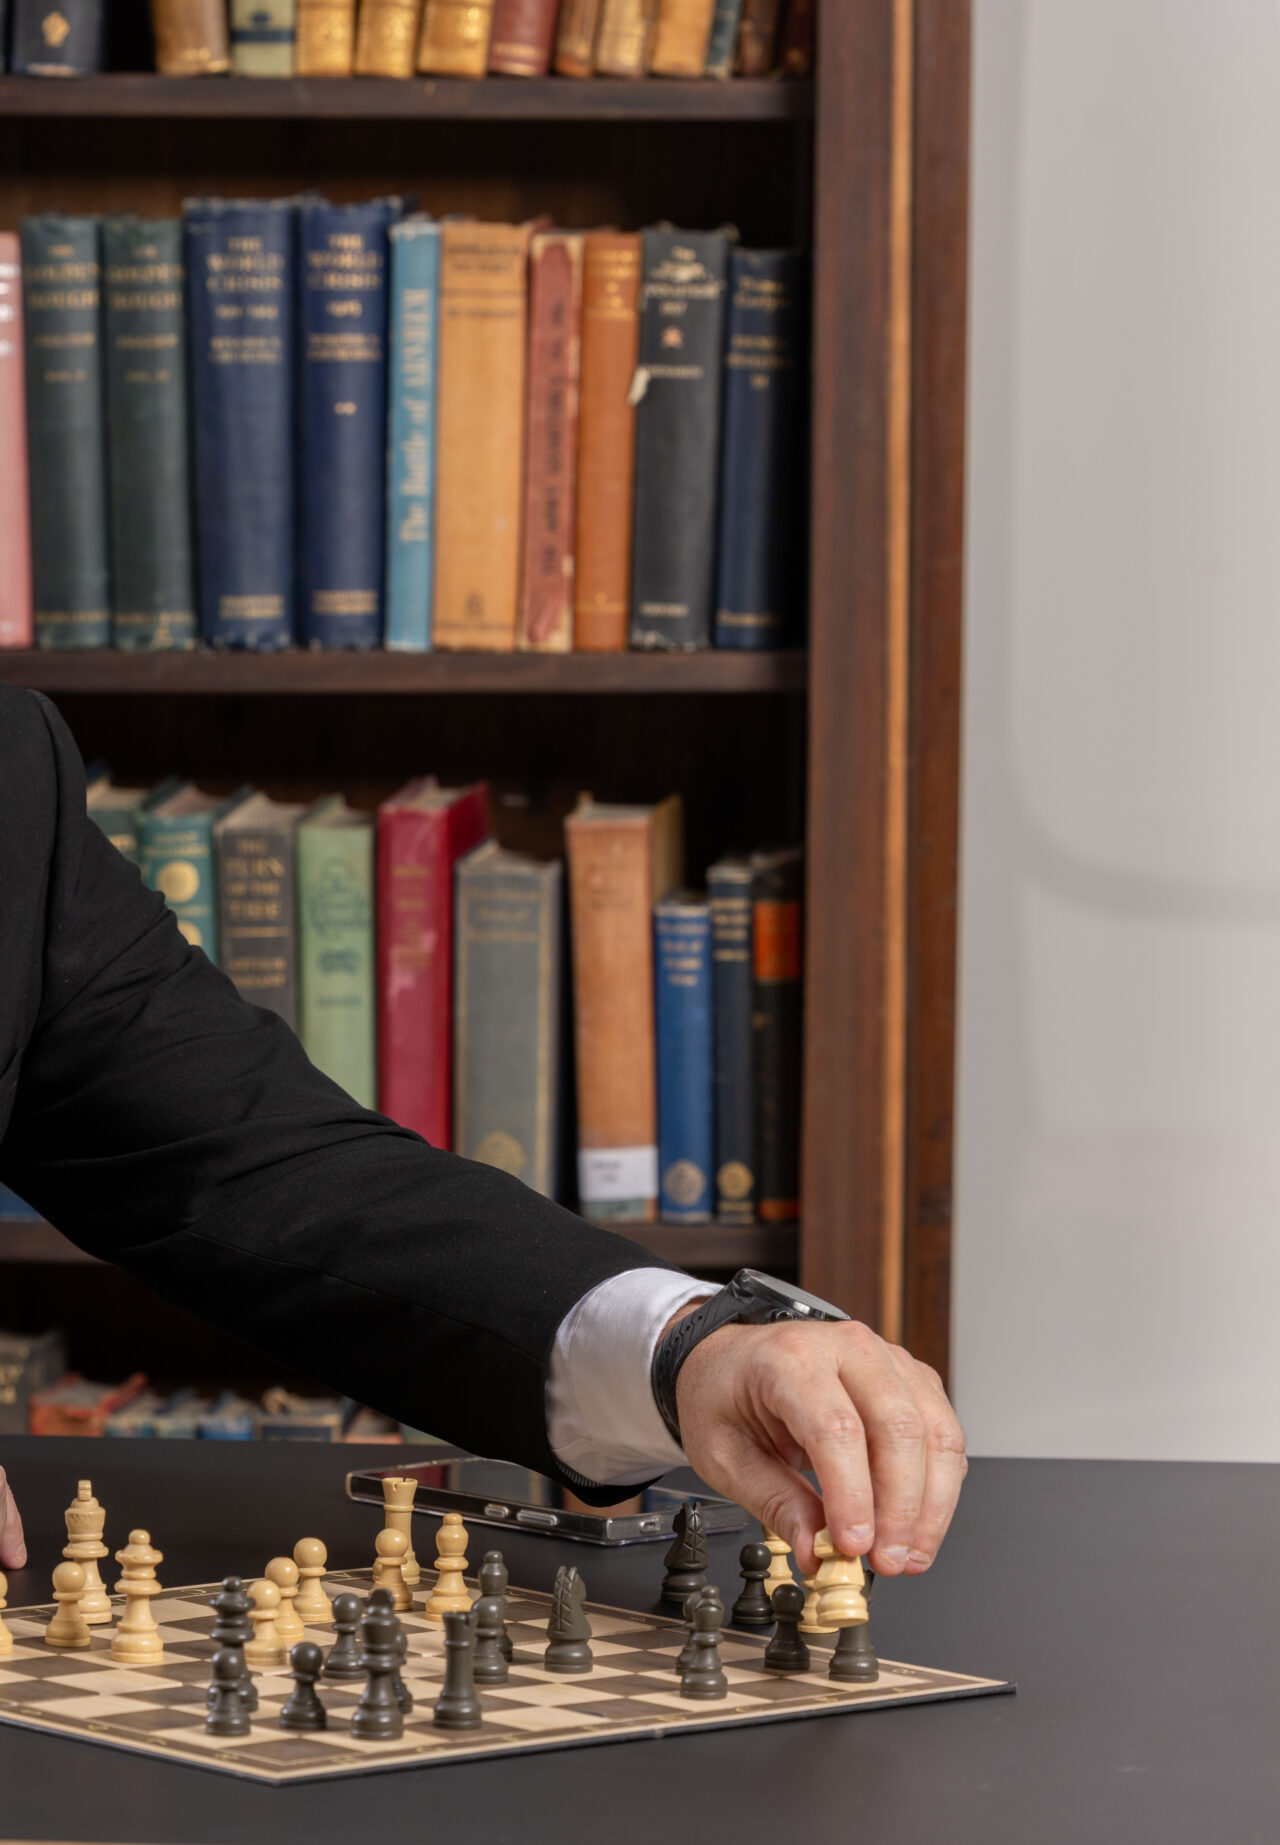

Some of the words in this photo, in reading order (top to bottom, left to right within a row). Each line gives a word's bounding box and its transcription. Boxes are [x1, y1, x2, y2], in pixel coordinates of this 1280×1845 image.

[228, 236, 262, 252] THE
[328, 235, 363, 251] THE
[206, 254, 284, 272] WORLD
[307, 252, 382, 271] WORLD
[207, 275, 283, 293] CRISIS
[308, 273, 381, 290] CRISIS
[401, 396, 429, 425] of
[399, 430, 429, 497] Battle
[399, 503, 428, 543] The
